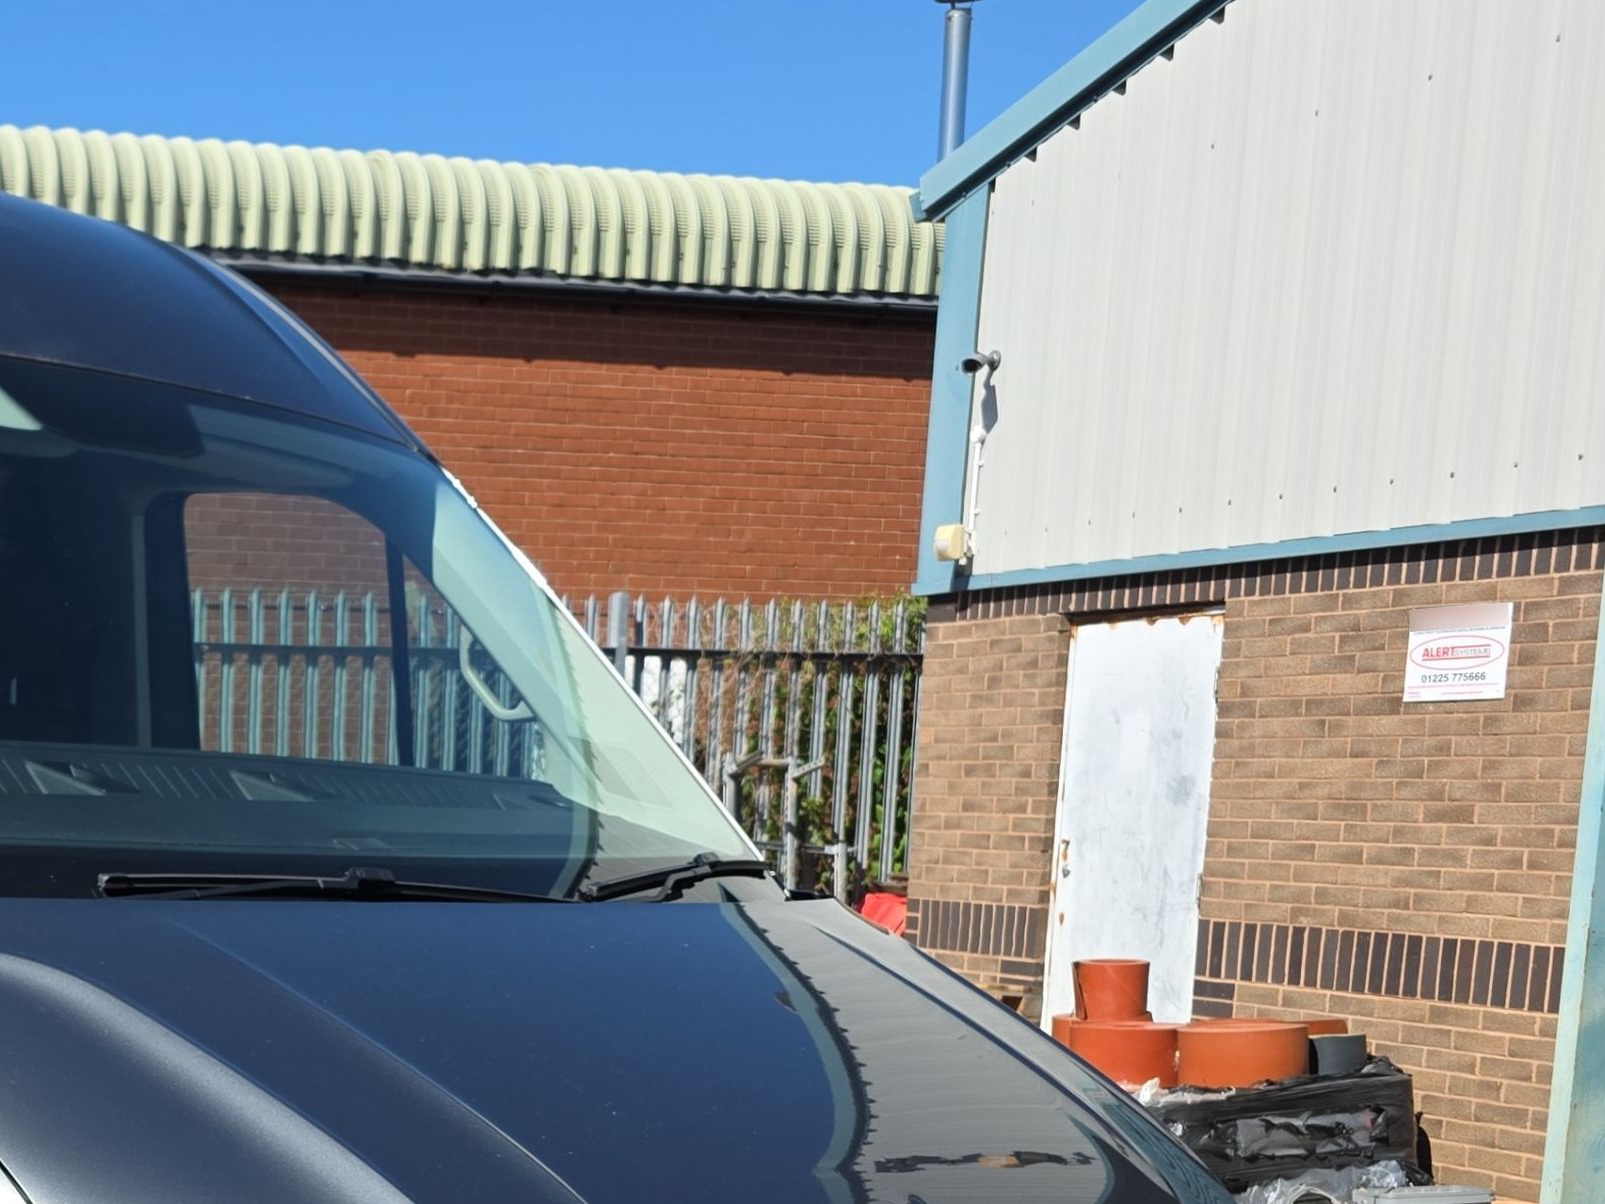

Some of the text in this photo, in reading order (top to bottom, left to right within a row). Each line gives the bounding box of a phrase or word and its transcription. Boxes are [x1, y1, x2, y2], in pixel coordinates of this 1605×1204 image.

[1422, 646, 1454, 658] ALERT
[1421, 672, 1486, 683] 01225 775666
